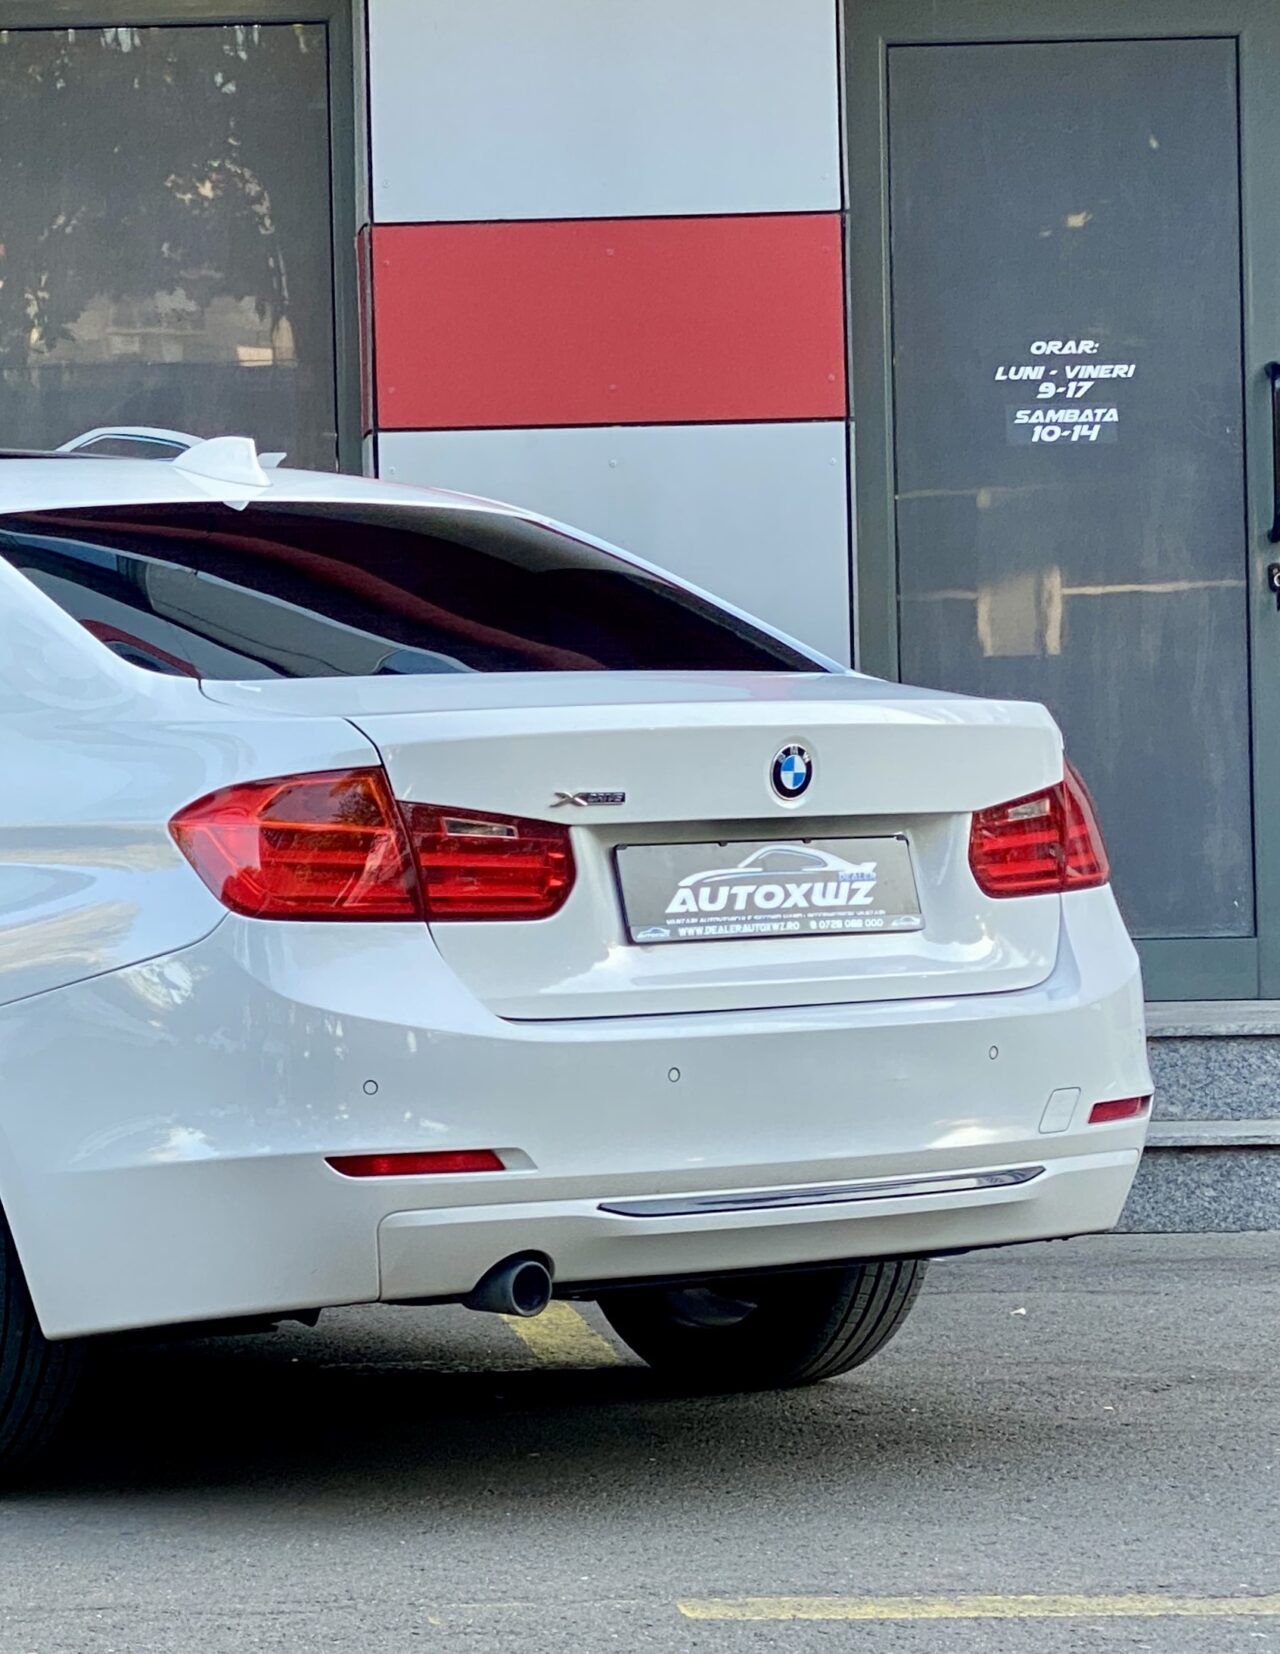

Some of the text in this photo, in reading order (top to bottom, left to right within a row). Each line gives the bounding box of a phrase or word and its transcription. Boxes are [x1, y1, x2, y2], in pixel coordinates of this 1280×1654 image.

[1030, 340, 1099, 355] ORAR:
[995, 366, 1045, 381] LUNI
[1065, 364, 1136, 379] VINERI
[1036, 381, 1094, 399] 9-17
[1014, 408, 1119, 424] SAMBATA
[1031, 424, 1101, 442] 10-14
[665, 880, 877, 913] AUTOXWZ
